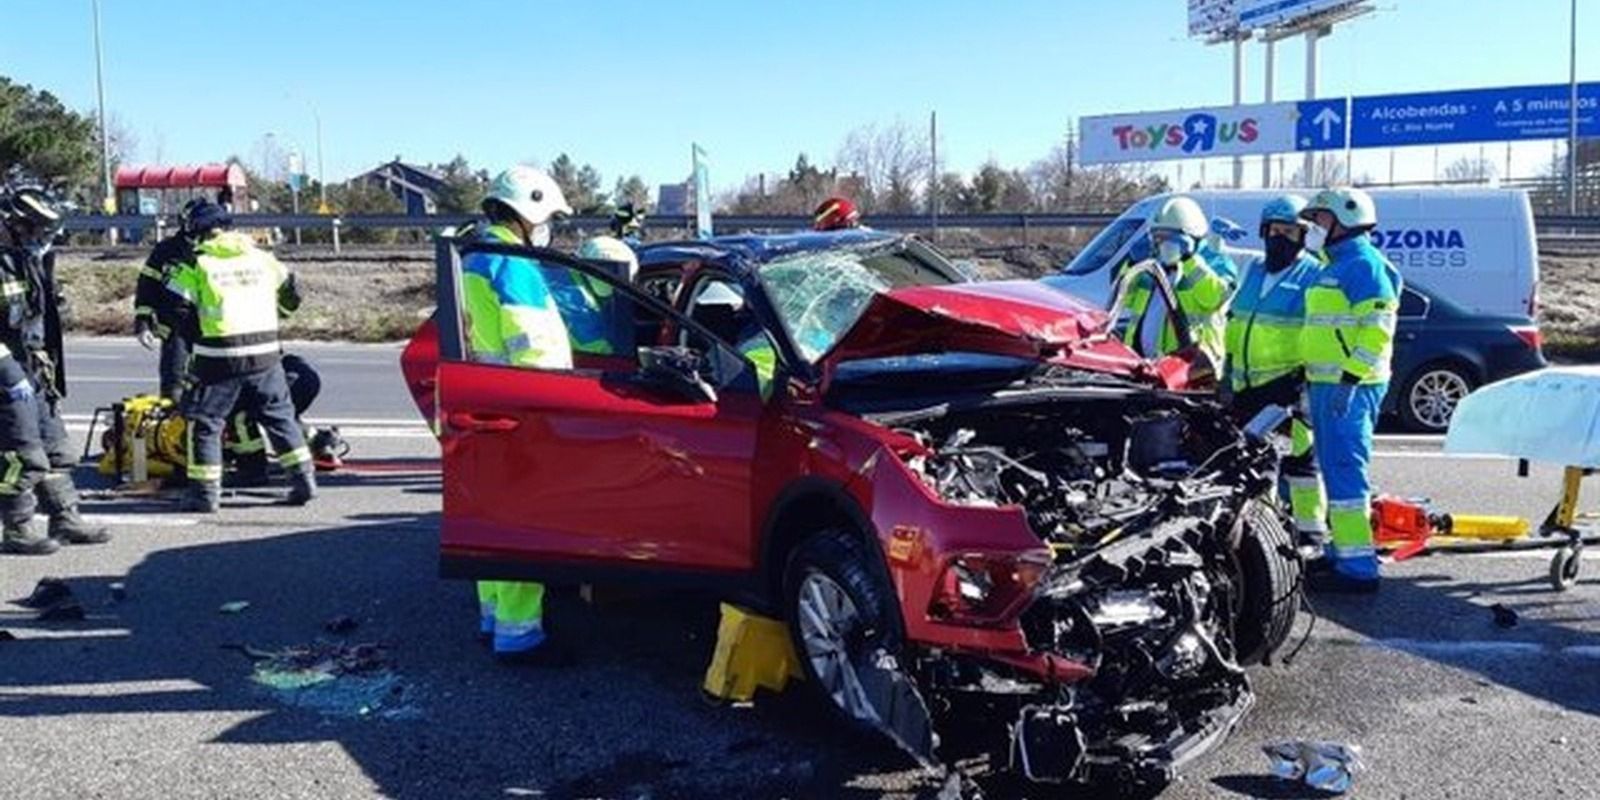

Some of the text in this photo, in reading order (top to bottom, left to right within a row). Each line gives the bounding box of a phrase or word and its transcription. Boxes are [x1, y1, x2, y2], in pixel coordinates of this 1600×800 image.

[1371, 103, 1467, 119] Alcobendas
[1494, 97, 1598, 114] A 5 minuos
